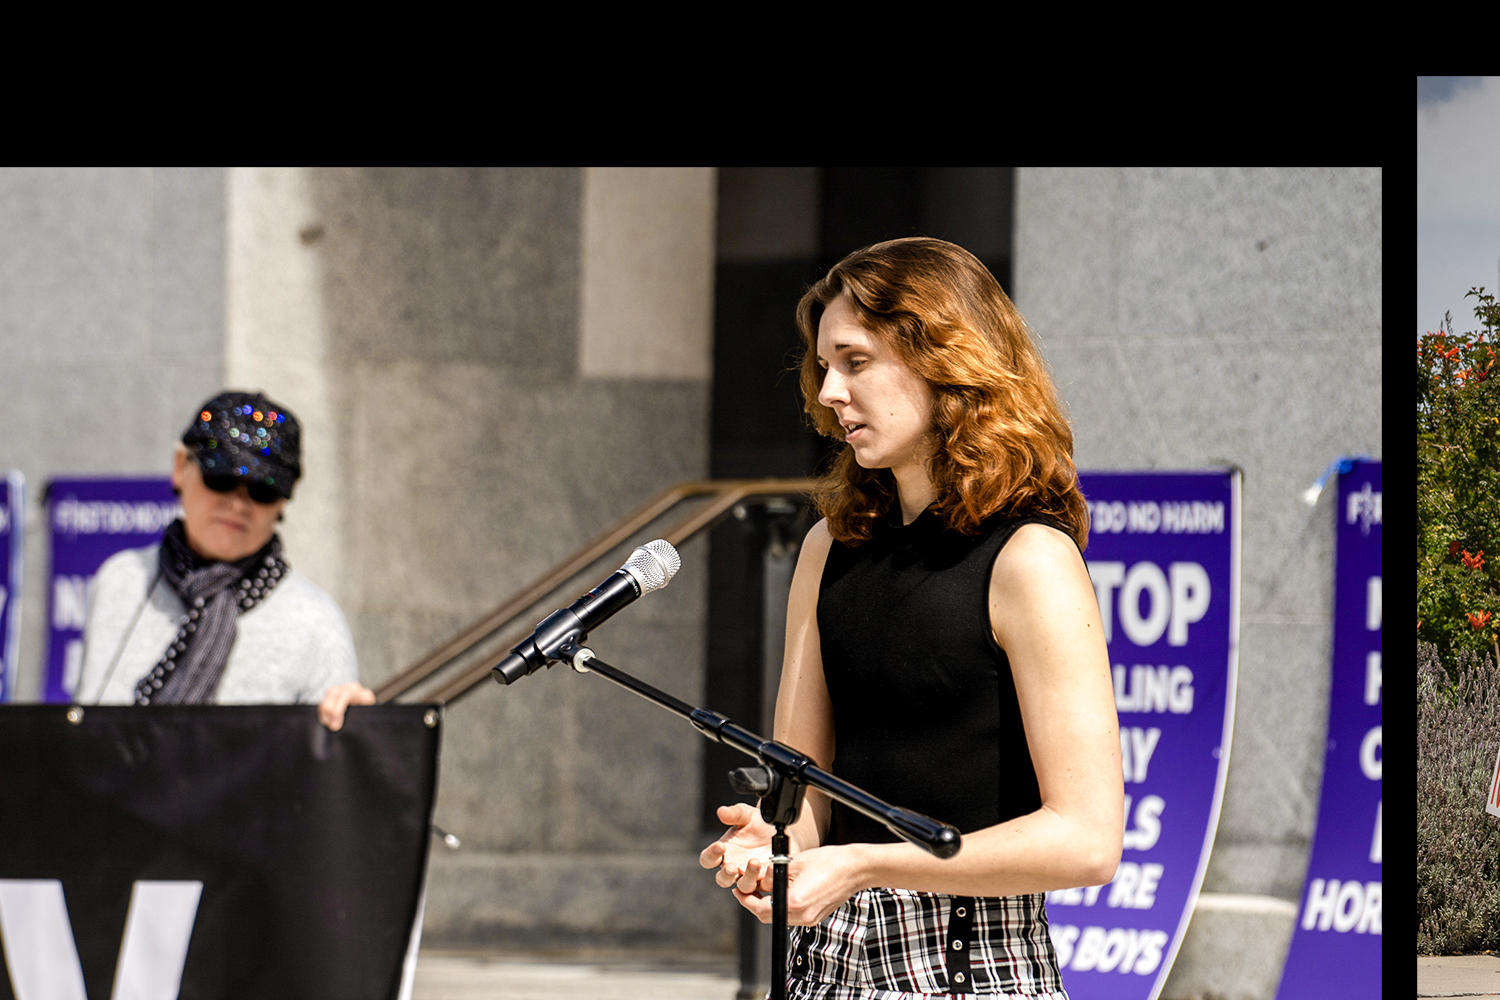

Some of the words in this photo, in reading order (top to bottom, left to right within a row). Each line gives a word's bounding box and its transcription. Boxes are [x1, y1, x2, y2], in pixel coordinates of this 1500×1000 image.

[1161, 500, 1225, 534] HARM
[1088, 561, 1211, 647] TOP
[1071, 926, 1168, 976] BOYS
